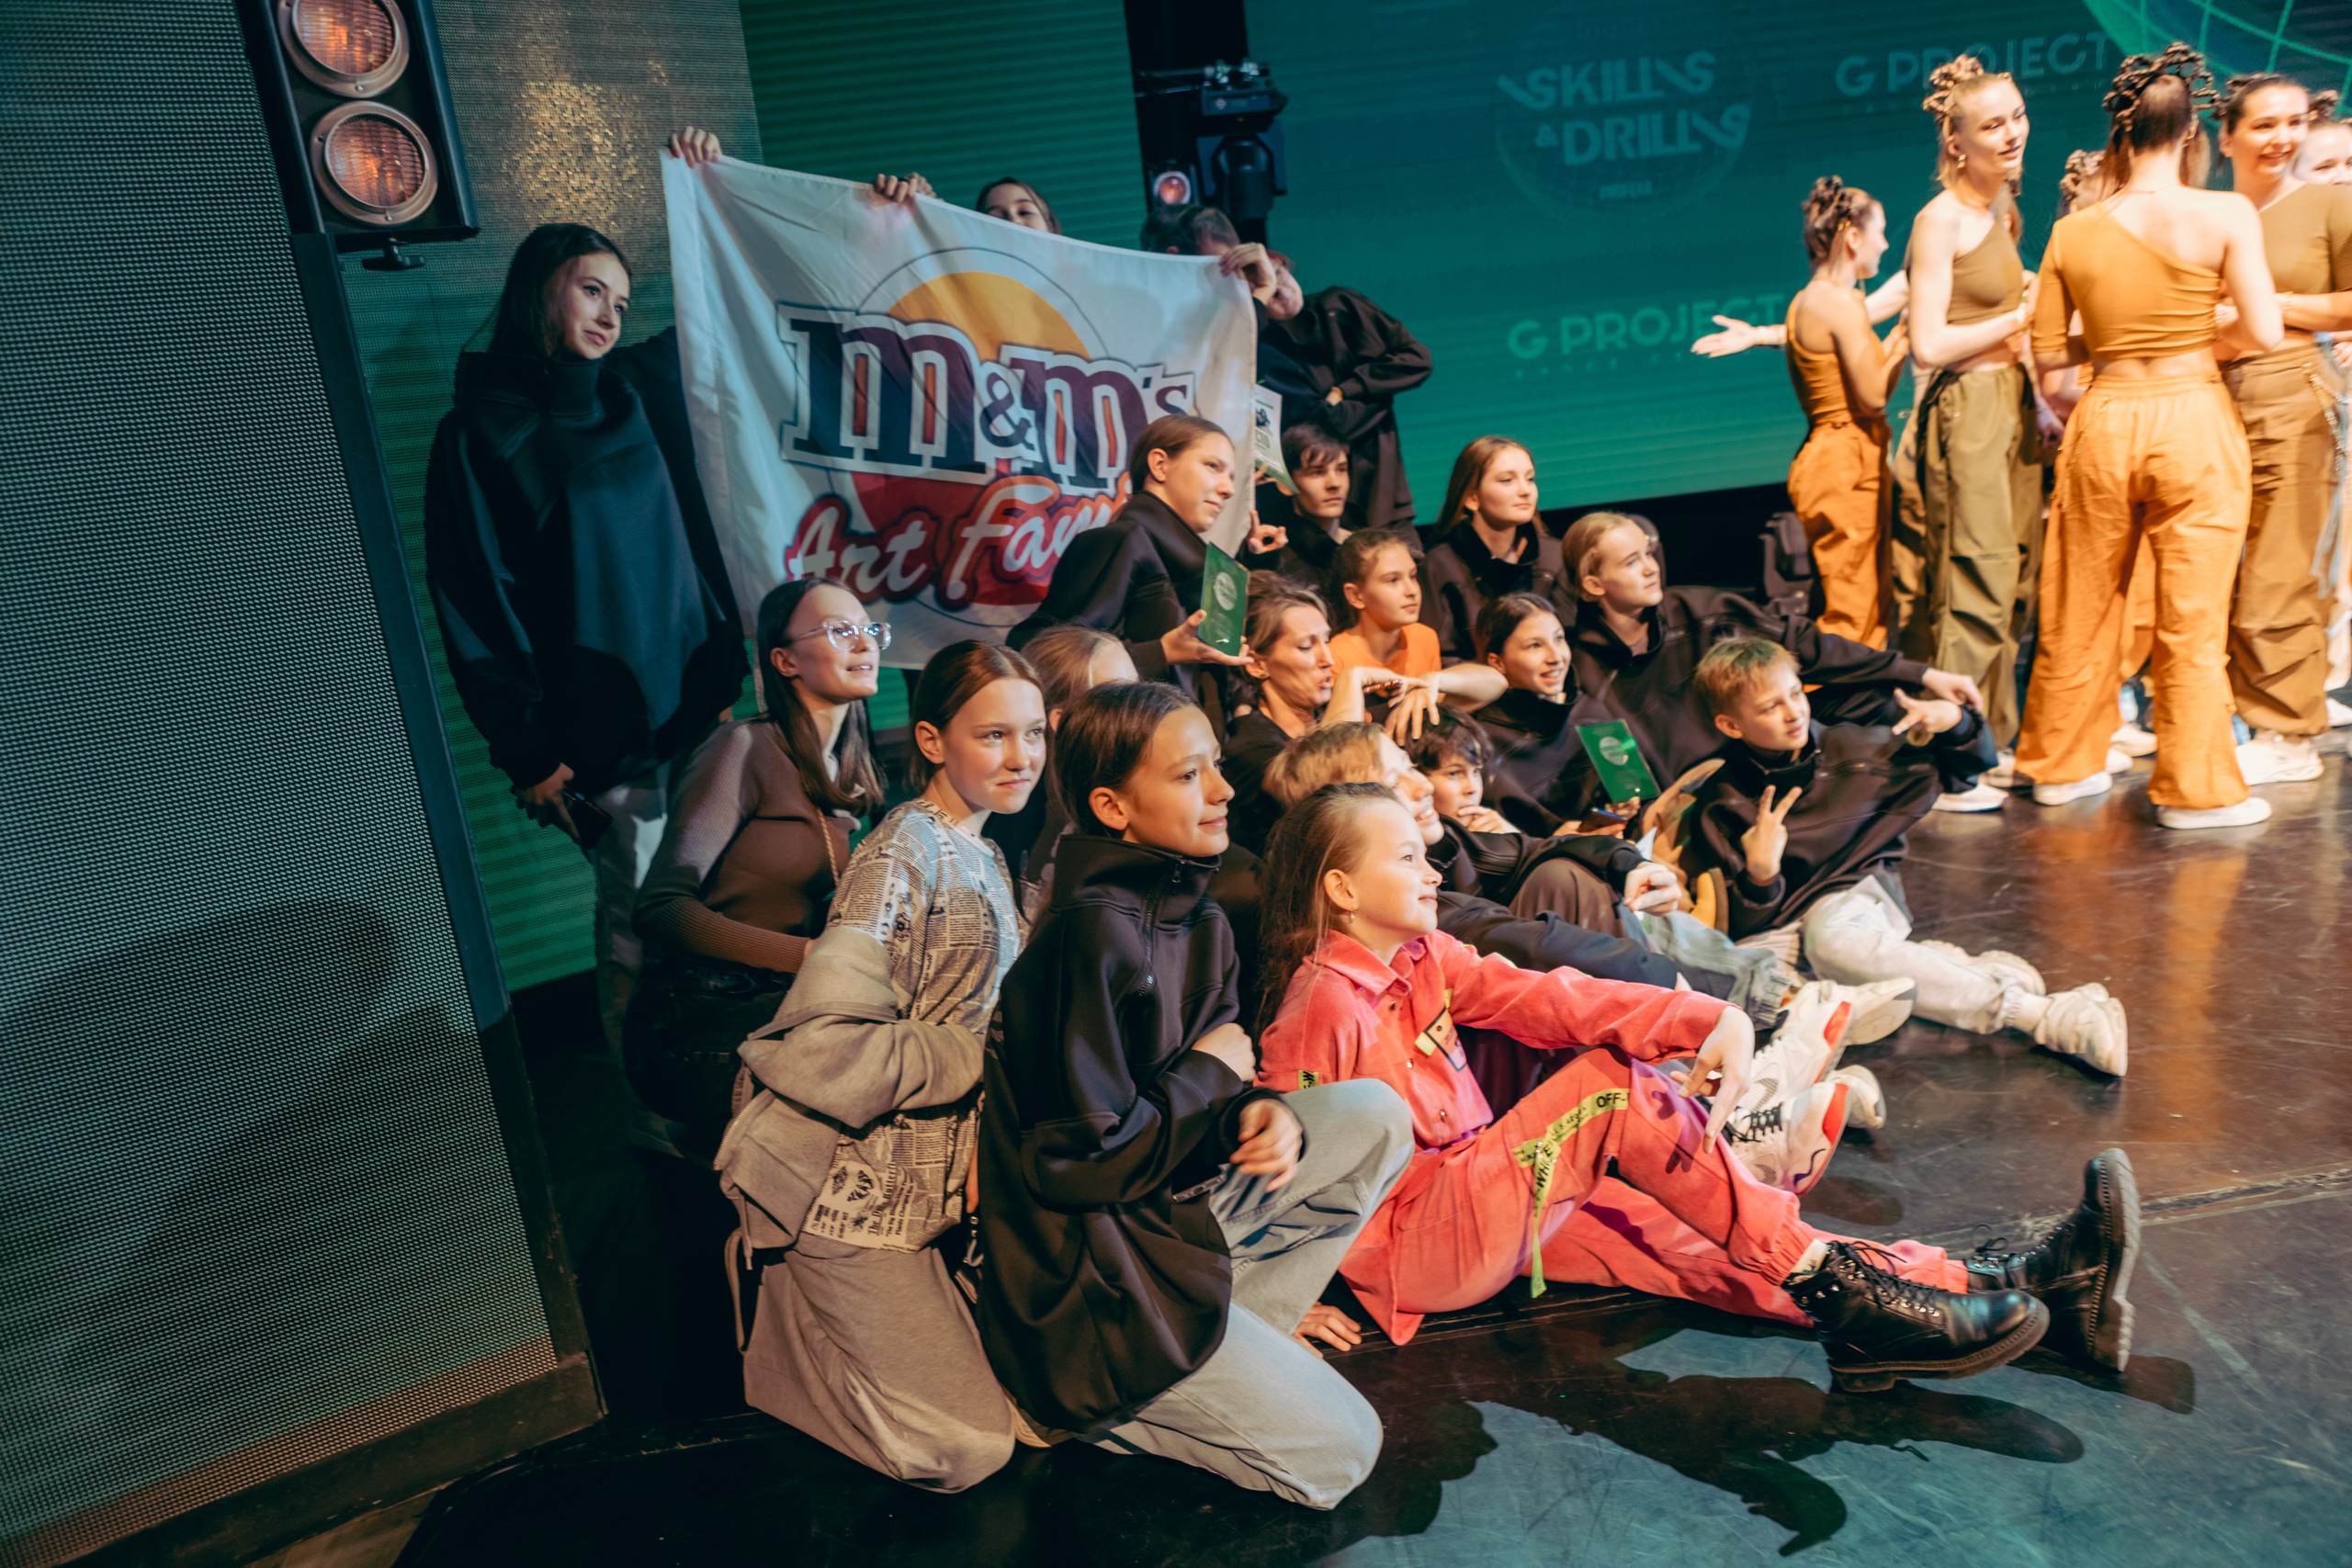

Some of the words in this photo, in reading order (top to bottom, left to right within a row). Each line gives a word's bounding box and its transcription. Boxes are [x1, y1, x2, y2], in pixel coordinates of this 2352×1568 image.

[1497, 50, 1716, 110] SKILLS
[1835, 54, 1875, 96] G
[1563, 104, 1751, 166] DRILLS
[1507, 320, 1549, 359] G
[786, 500, 931, 597] Art
[1597, 1092, 1629, 1109] OFF-
